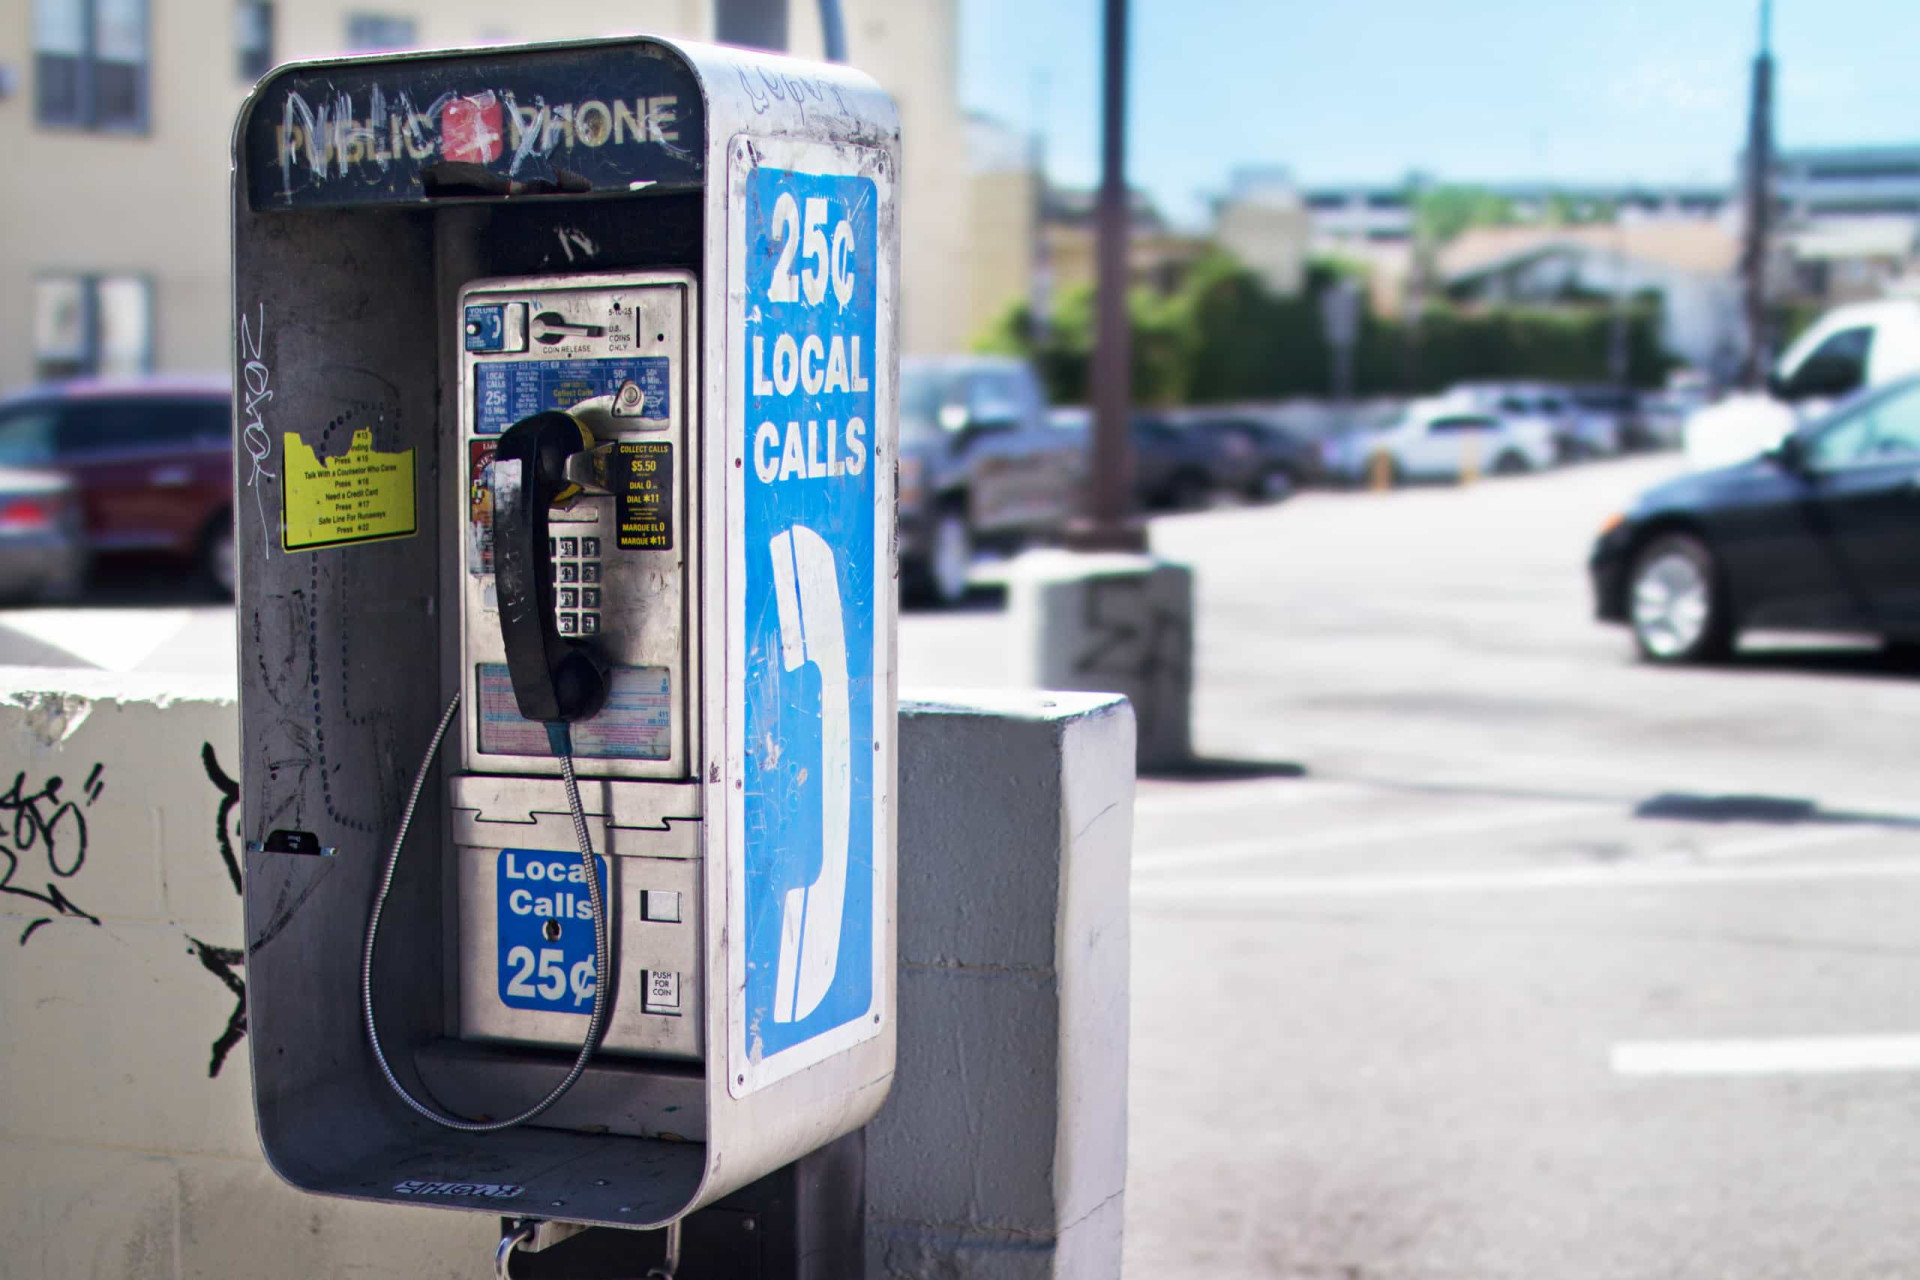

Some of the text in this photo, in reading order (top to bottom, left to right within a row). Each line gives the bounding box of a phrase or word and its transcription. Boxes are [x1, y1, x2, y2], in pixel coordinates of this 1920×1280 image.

[275, 96, 679, 167] PUBLIC PHONE
[767, 191, 855, 315] 25¢
[609, 334, 630, 342] COINS
[543, 345, 592, 354] COIN RELEASE
[609, 344, 627, 352] ONLY
[753, 333, 868, 398] LOCAL
[486, 372, 505, 380] LOCAL
[486, 380, 506, 388] CALLS
[485, 391, 507, 406] 25¢
[620, 446, 648, 454] COLLECT
[648, 445, 669, 453] CALLS
[754, 417, 866, 484] CALLS
[334, 457, 350, 465] Press
[631, 460, 657, 472] $5.50
[304, 471, 316, 480] Talk
[318, 470, 331, 478] With
[337, 466, 367, 476] Counselor
[367, 465, 380, 474] Who
[380, 464, 397, 472] Cares
[335, 480, 351, 488] Press
[629, 481, 645, 490] DIAL
[646, 480, 652, 490] 0
[325, 492, 341, 500] Need
[346, 490, 364, 498] Credit
[365, 488, 379, 496] Card
[626, 495, 643, 504] DIAL
[336, 503, 352, 511] Press
[318, 511, 386, 525] Safe Line For Runaways
[337, 526, 353, 534] Press
[622, 521, 665, 532] MARQUE EL 0
[621, 536, 649, 545] MARQUE
[506, 854, 598, 883] Loca
[509, 889, 594, 920] Calls
[506, 946, 597, 1007] 25¢
[652, 971, 672, 979] PUSH
[655, 980, 669, 988] FOR
[652, 988, 672, 996] COIN
